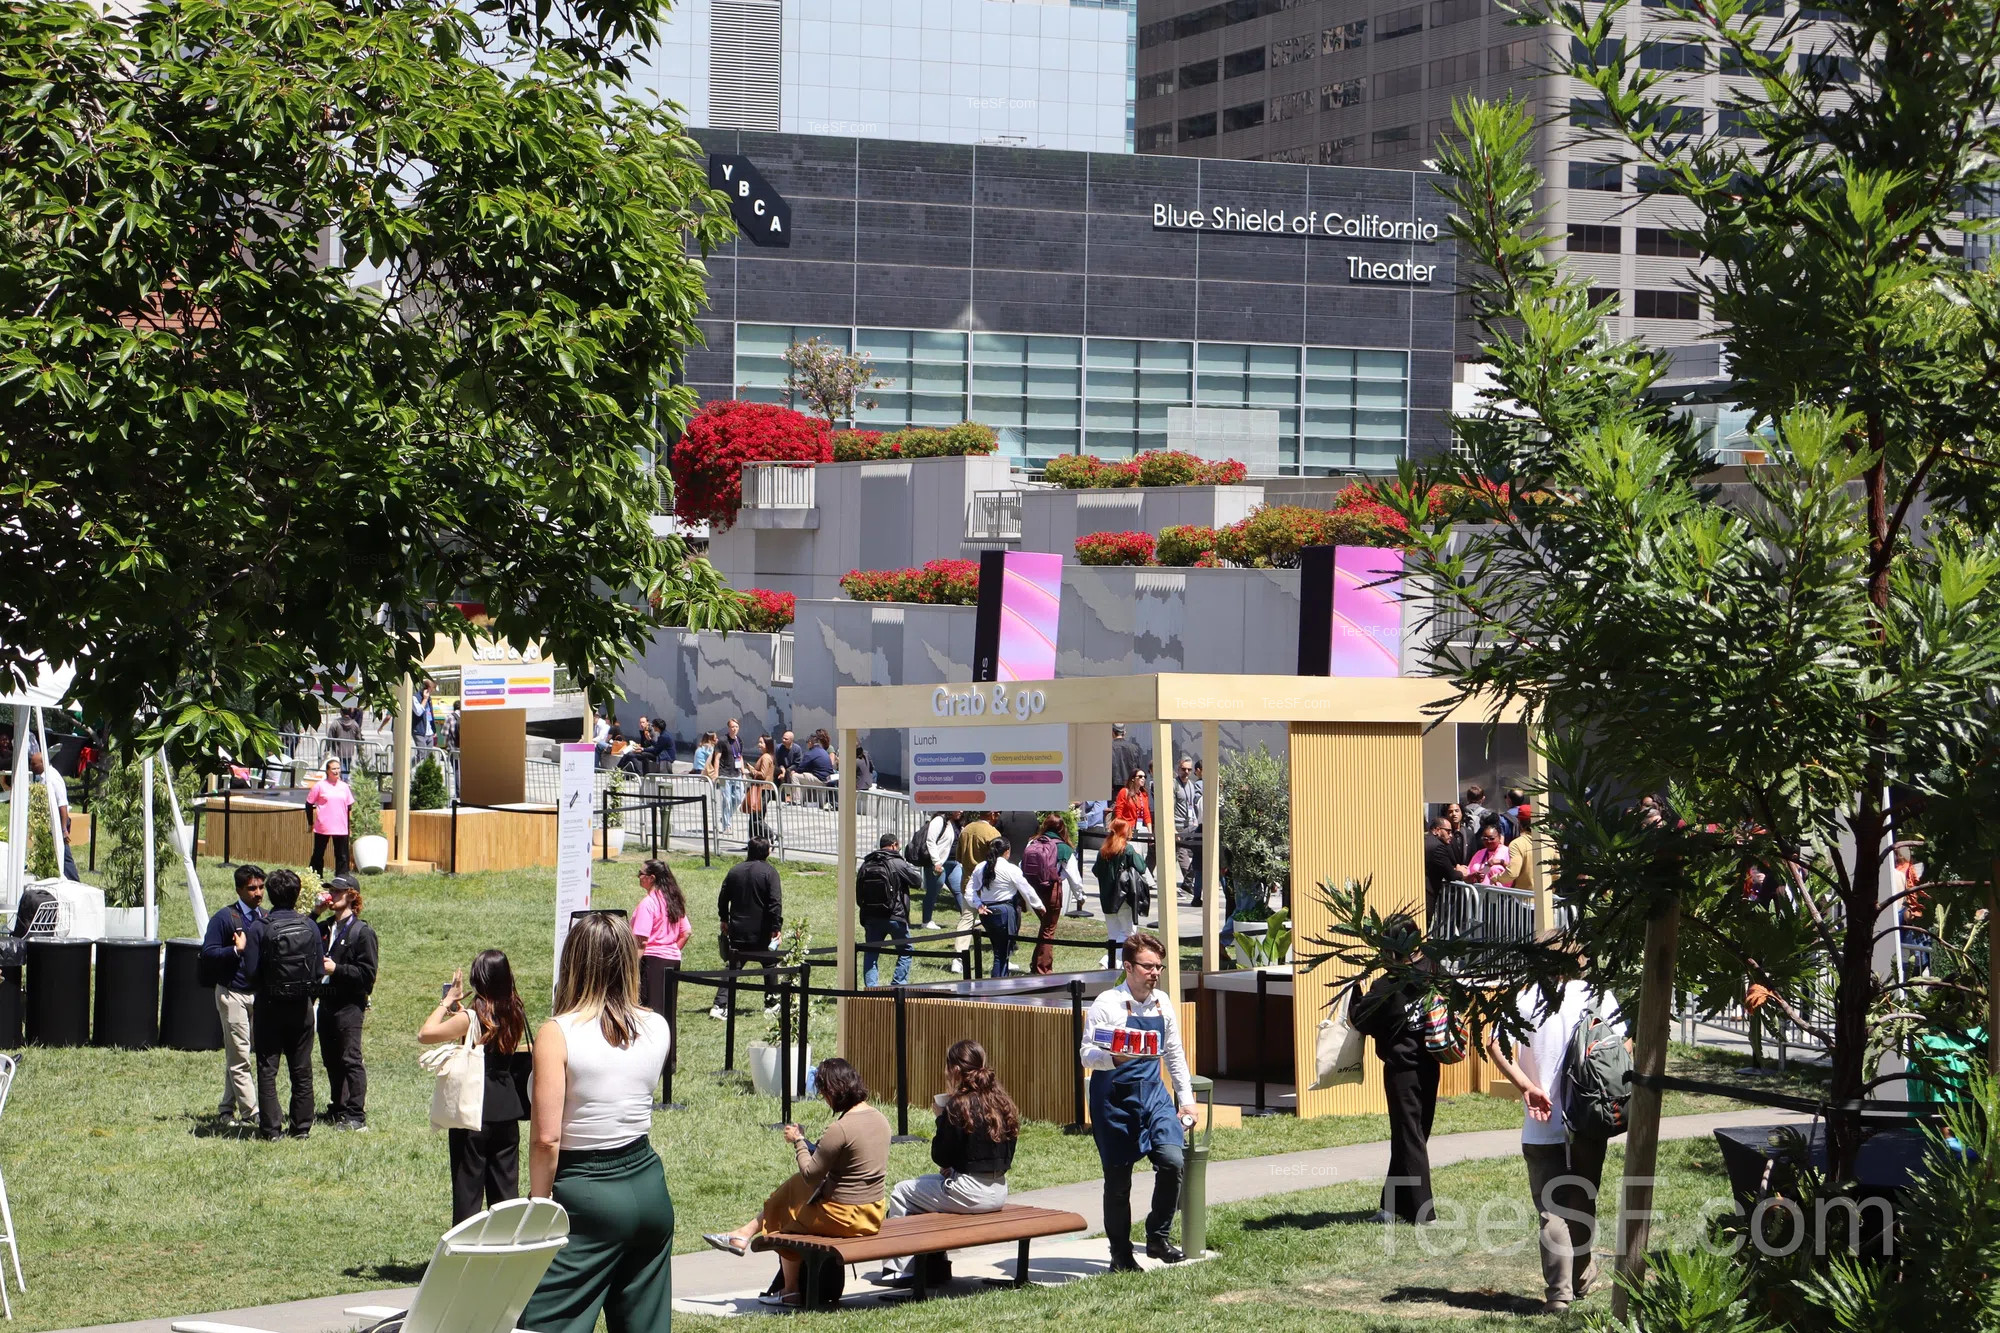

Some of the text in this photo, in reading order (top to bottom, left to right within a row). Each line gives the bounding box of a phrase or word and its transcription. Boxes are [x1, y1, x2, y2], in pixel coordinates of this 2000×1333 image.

[1153, 204, 1438, 240] Blue Shield of California
[1347, 256, 1437, 282] Theater
[932, 684, 1047, 721] Grab & go
[913, 734, 938, 746] Lunch
